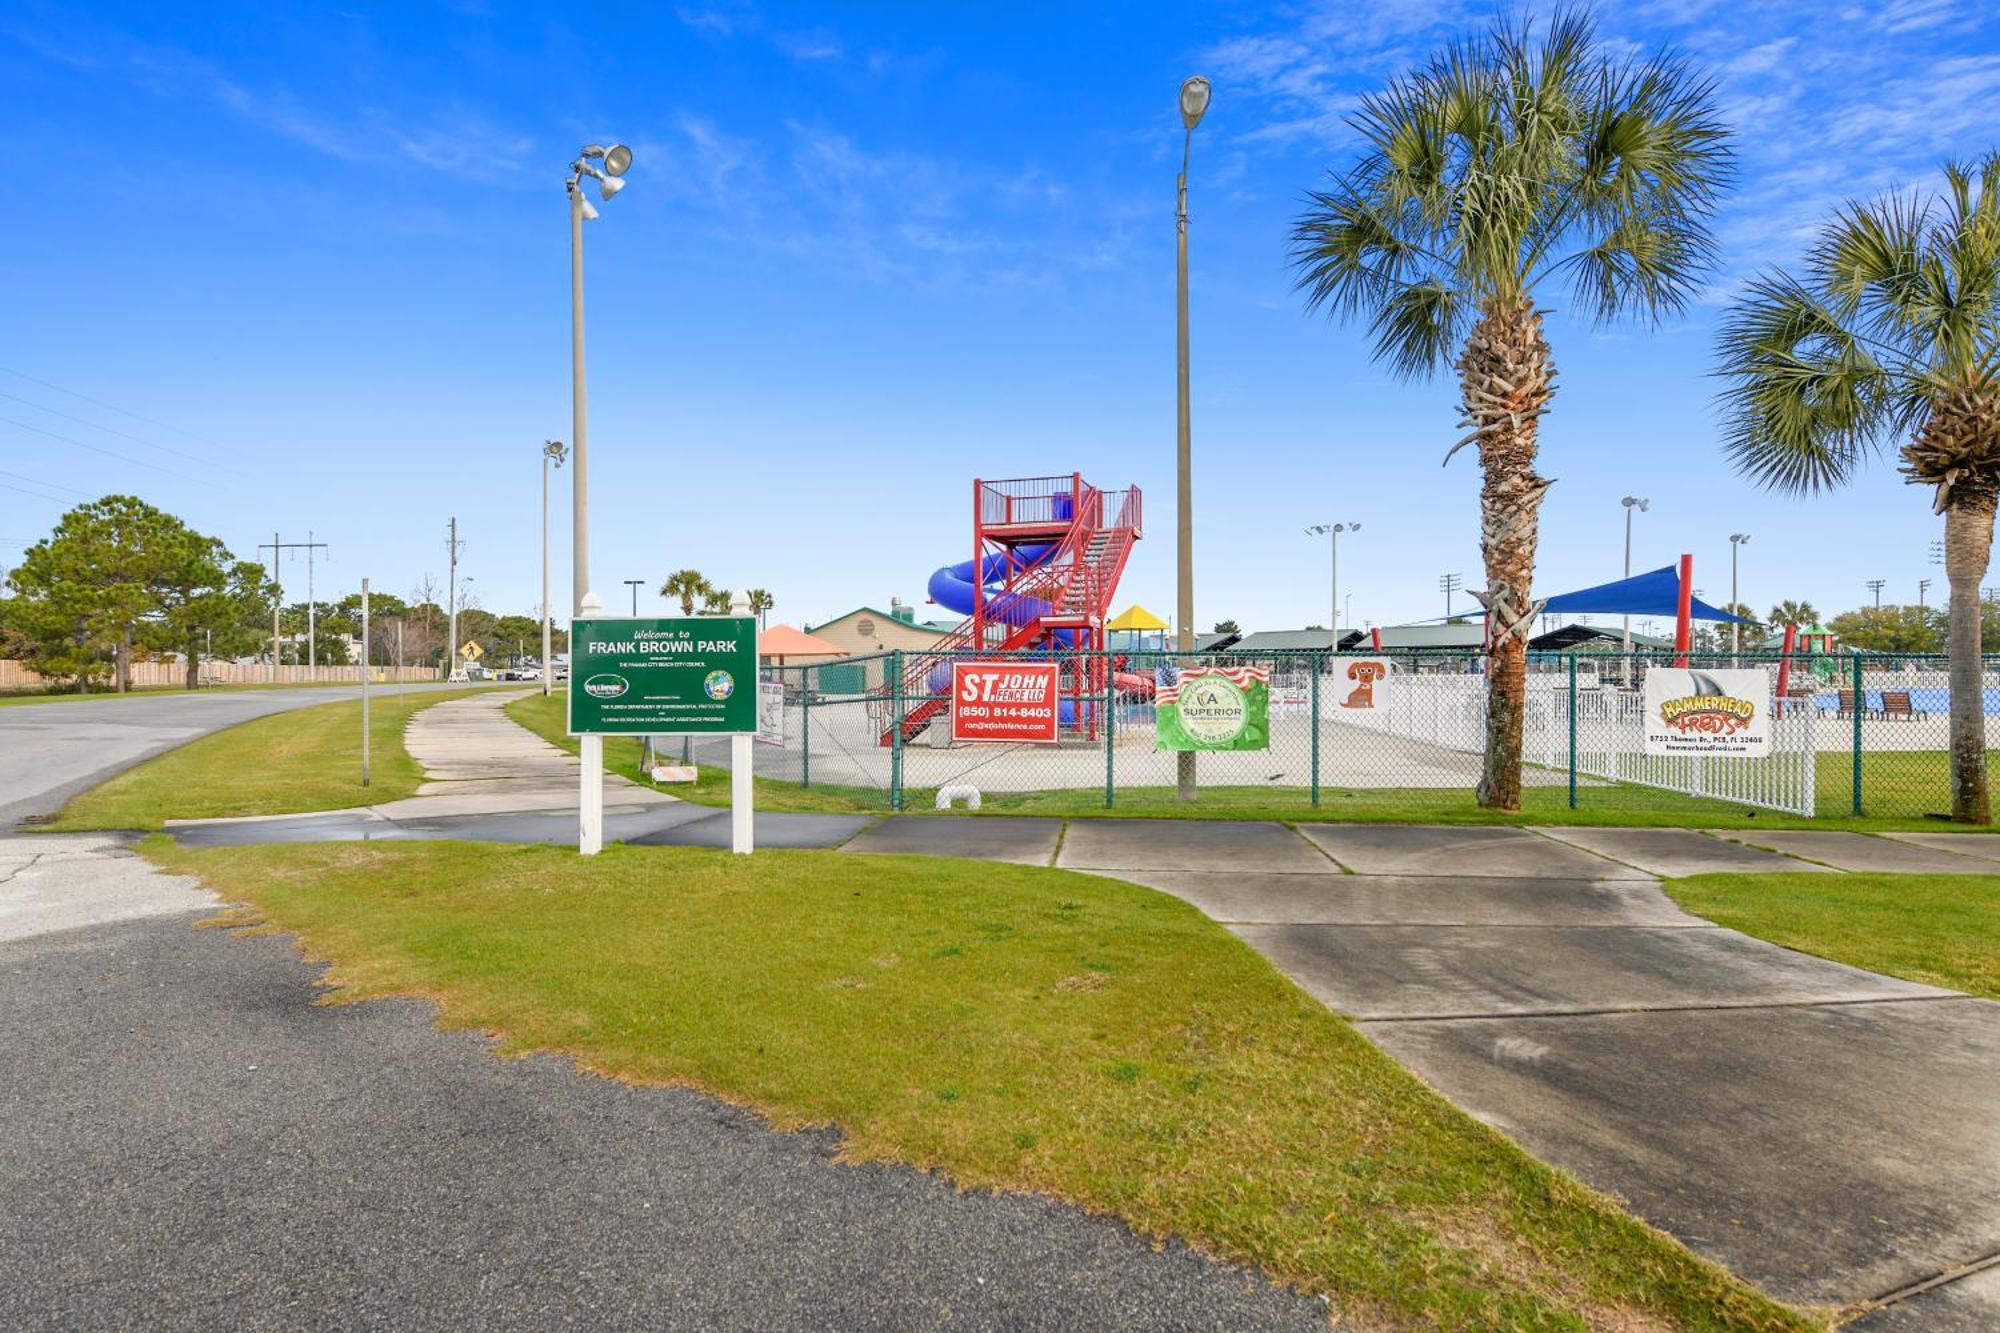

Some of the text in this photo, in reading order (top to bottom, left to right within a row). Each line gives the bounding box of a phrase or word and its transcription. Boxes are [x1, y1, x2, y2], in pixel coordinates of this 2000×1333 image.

[633, 630, 690, 640] Welcome to
[589, 640, 737, 654] FRANK BROWN PARK
[961, 673, 1049, 702] ST. JOHN
[997, 689, 1045, 702] FENCE LLC
[1206, 693, 1218, 704] A
[960, 706, 1052, 718] (850) 814-8403
[1183, 708, 1242, 716] SUPERIOR
[1661, 695, 1755, 719] HAMMERHEAD
